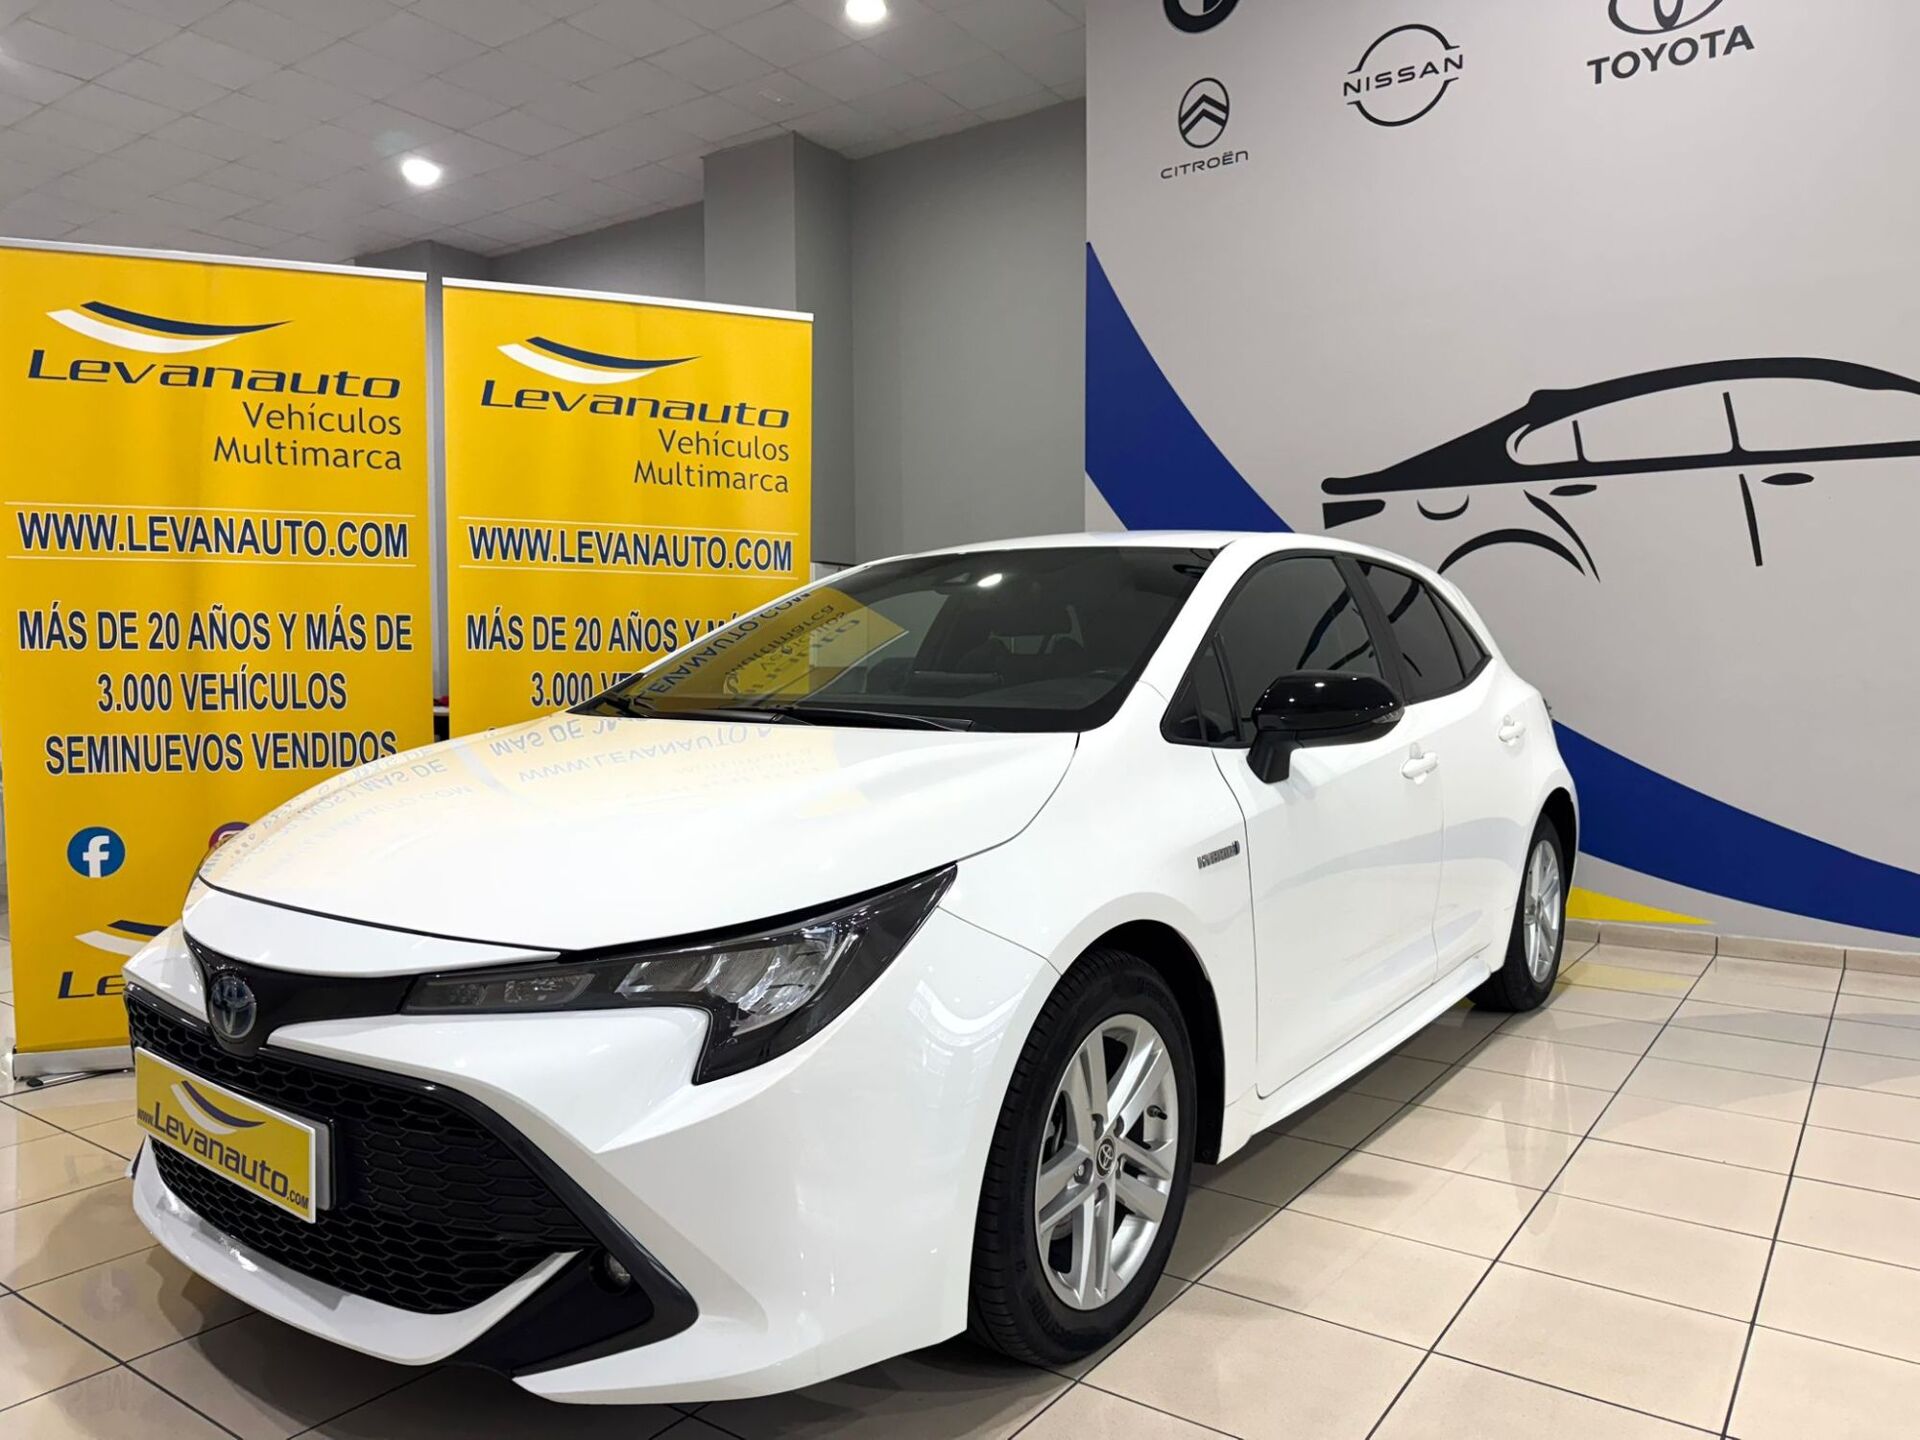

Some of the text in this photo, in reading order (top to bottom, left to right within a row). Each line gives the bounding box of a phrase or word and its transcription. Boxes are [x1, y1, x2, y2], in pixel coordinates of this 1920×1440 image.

[1343, 54, 1463, 97] NISSAN
[1586, 25, 1755, 85] TOYOTA
[1160, 150, 1249, 180] CITROËN
[28, 348, 401, 399] Levanauto
[242, 401, 402, 436] Vehículos
[480, 379, 790, 429] Levanauto
[213, 436, 402, 470] Multimarca
[658, 428, 790, 462] Vehículos
[633, 459, 789, 493] Multimarca
[17, 511, 409, 558] WWW.LEVANAUTO.COM
[468, 525, 792, 572] WWW.LEVANAUTO.COM
[18, 601, 413, 652] MÁS DE 20 AÑOS Y MÁS DE
[466, 606, 524, 651] MÁS
[532, 615, 567, 651] DE
[574, 616, 602, 652] 20
[607, 610, 678, 653] AÑOS
[684, 618, 701, 641] Y
[96, 663, 347, 712] 3.000 VEHÍCULOS
[531, 671, 594, 706] 3.000
[45, 732, 244, 775] SEMINUEVOS
[251, 730, 397, 769] VENDIDOS
